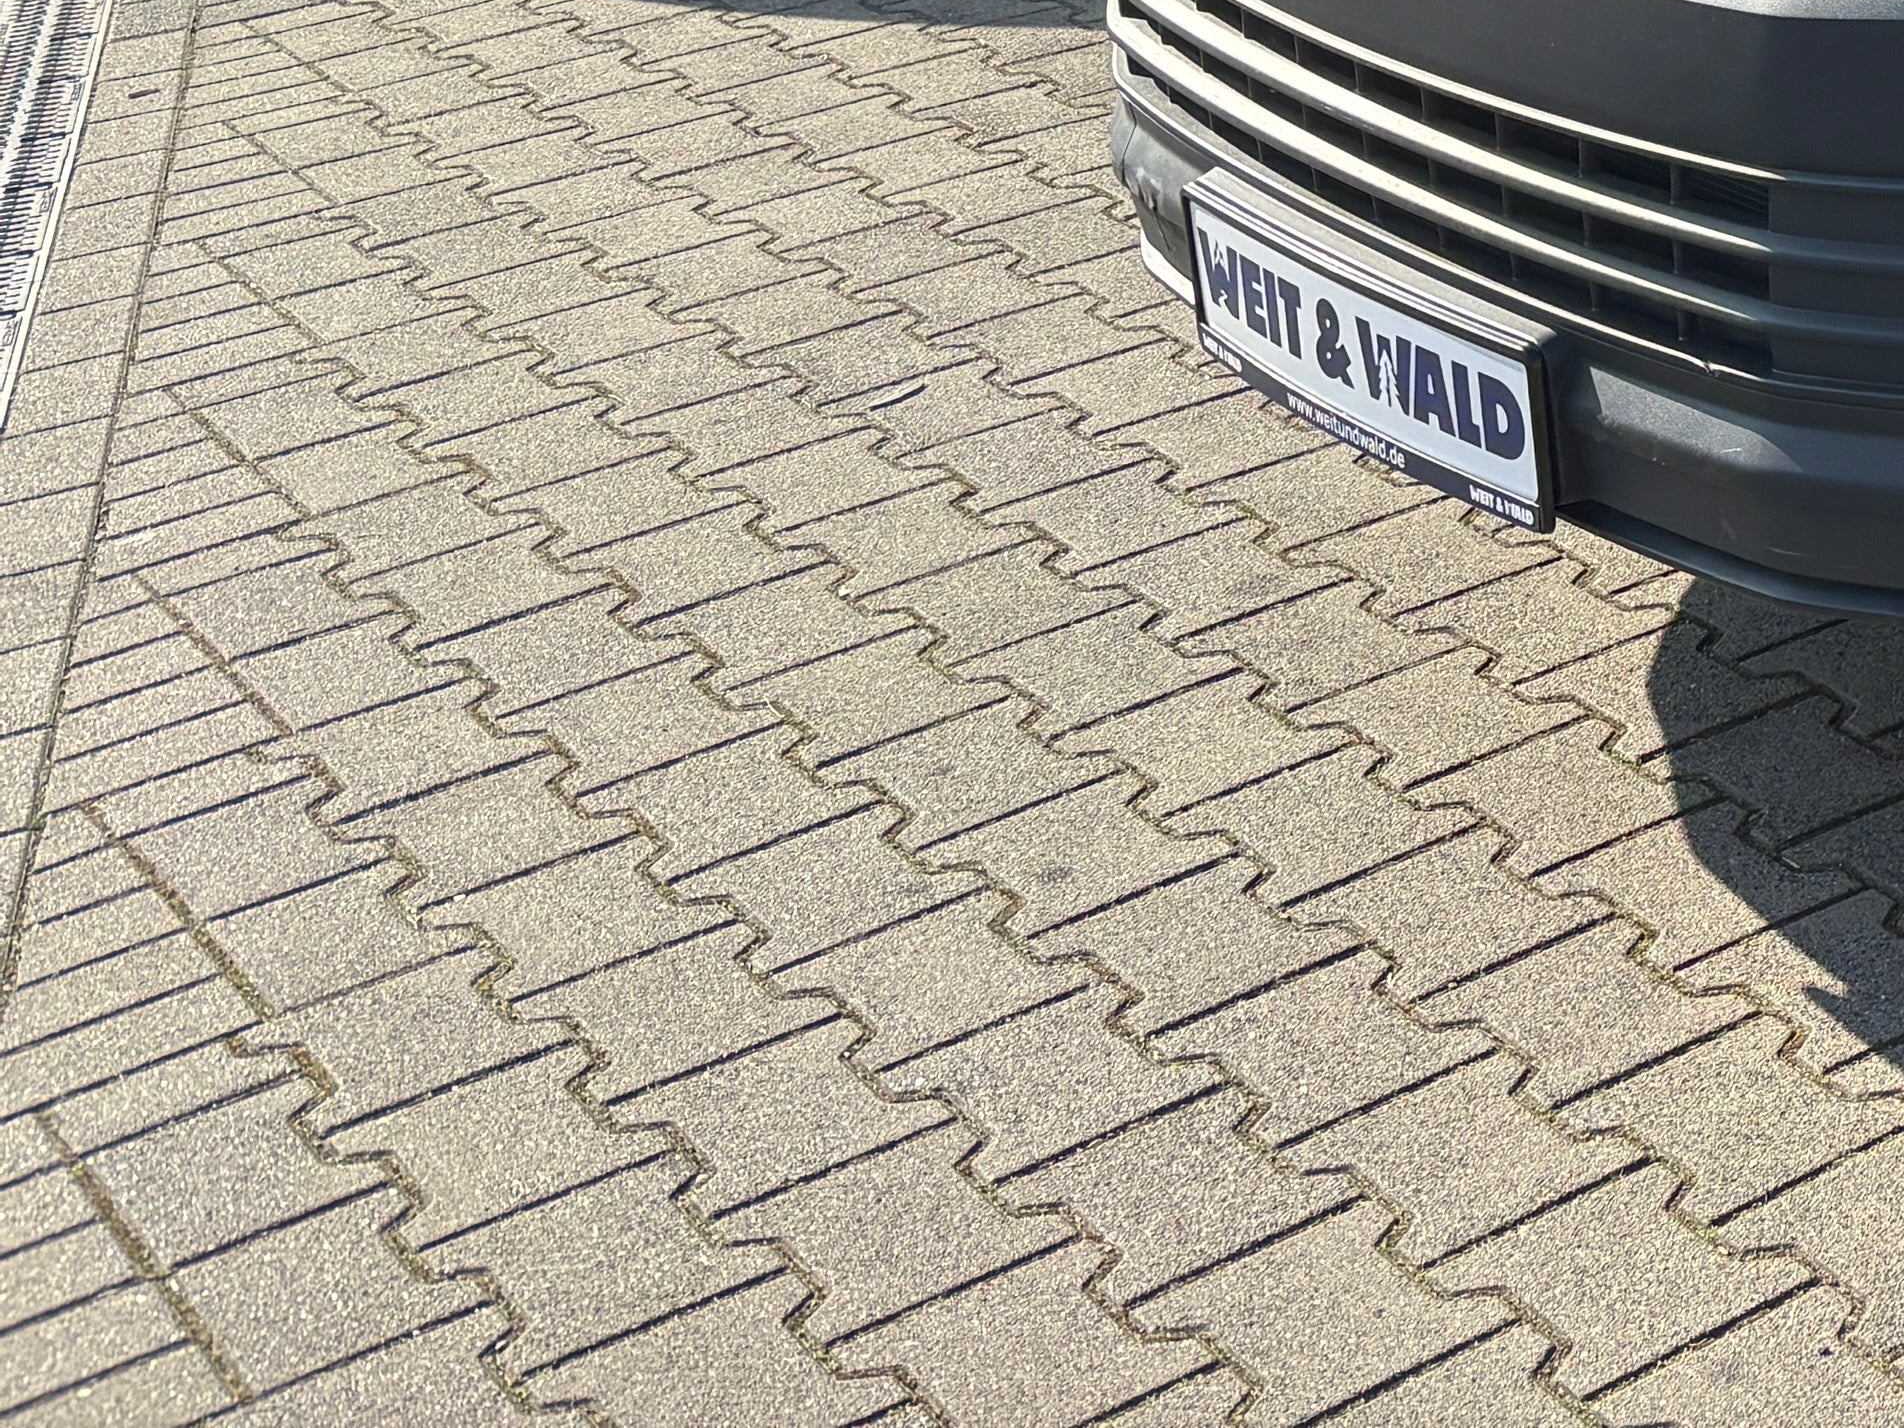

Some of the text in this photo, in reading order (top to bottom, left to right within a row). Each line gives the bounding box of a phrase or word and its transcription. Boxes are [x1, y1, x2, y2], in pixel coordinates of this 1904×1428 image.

[1197, 227, 1525, 460] WEIT & WALD
[1287, 392, 1406, 469] www.weitundwald.de
